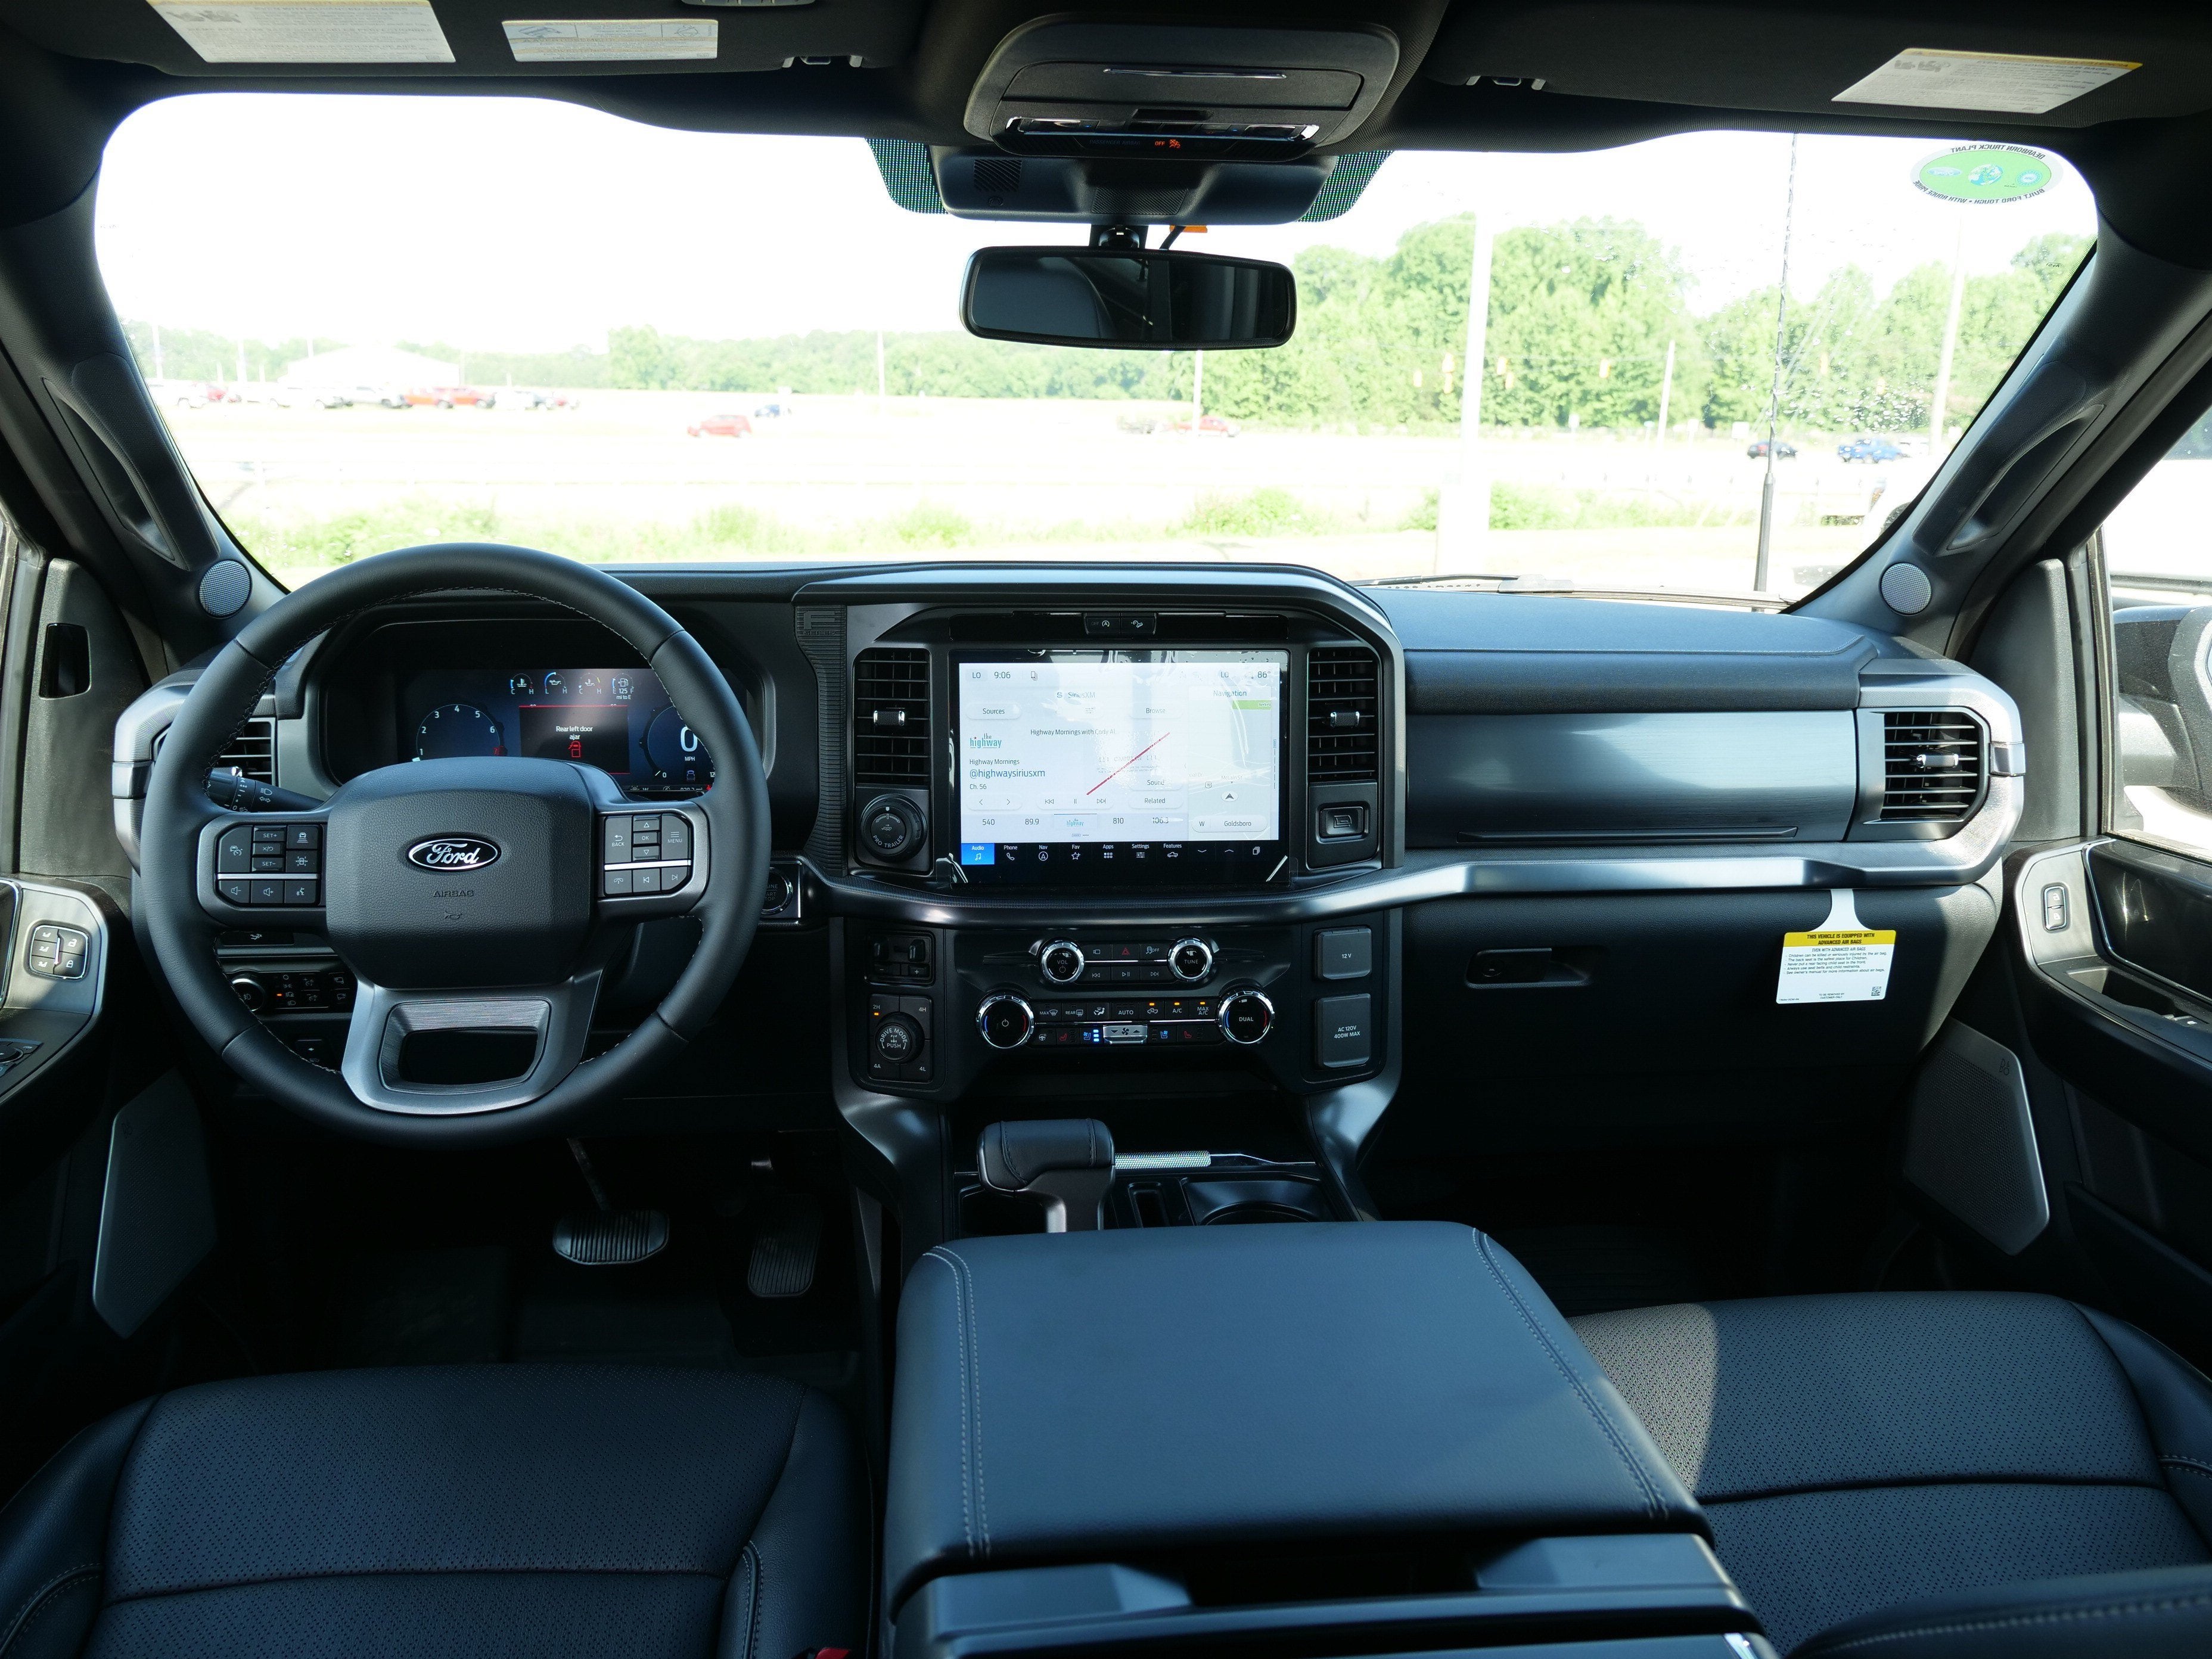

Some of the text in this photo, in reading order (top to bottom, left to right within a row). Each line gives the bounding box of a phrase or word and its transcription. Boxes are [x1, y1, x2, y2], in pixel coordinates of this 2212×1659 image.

[681, 726, 698, 752] 0
[970, 737, 1002, 748] highway
[969, 769, 1045, 779] @highwaysiriusxm
[872, 835, 904, 848] PRO TRAILER
[426, 843, 481, 864] Ford
[880, 1027, 908, 1043] DRIVE MODE
